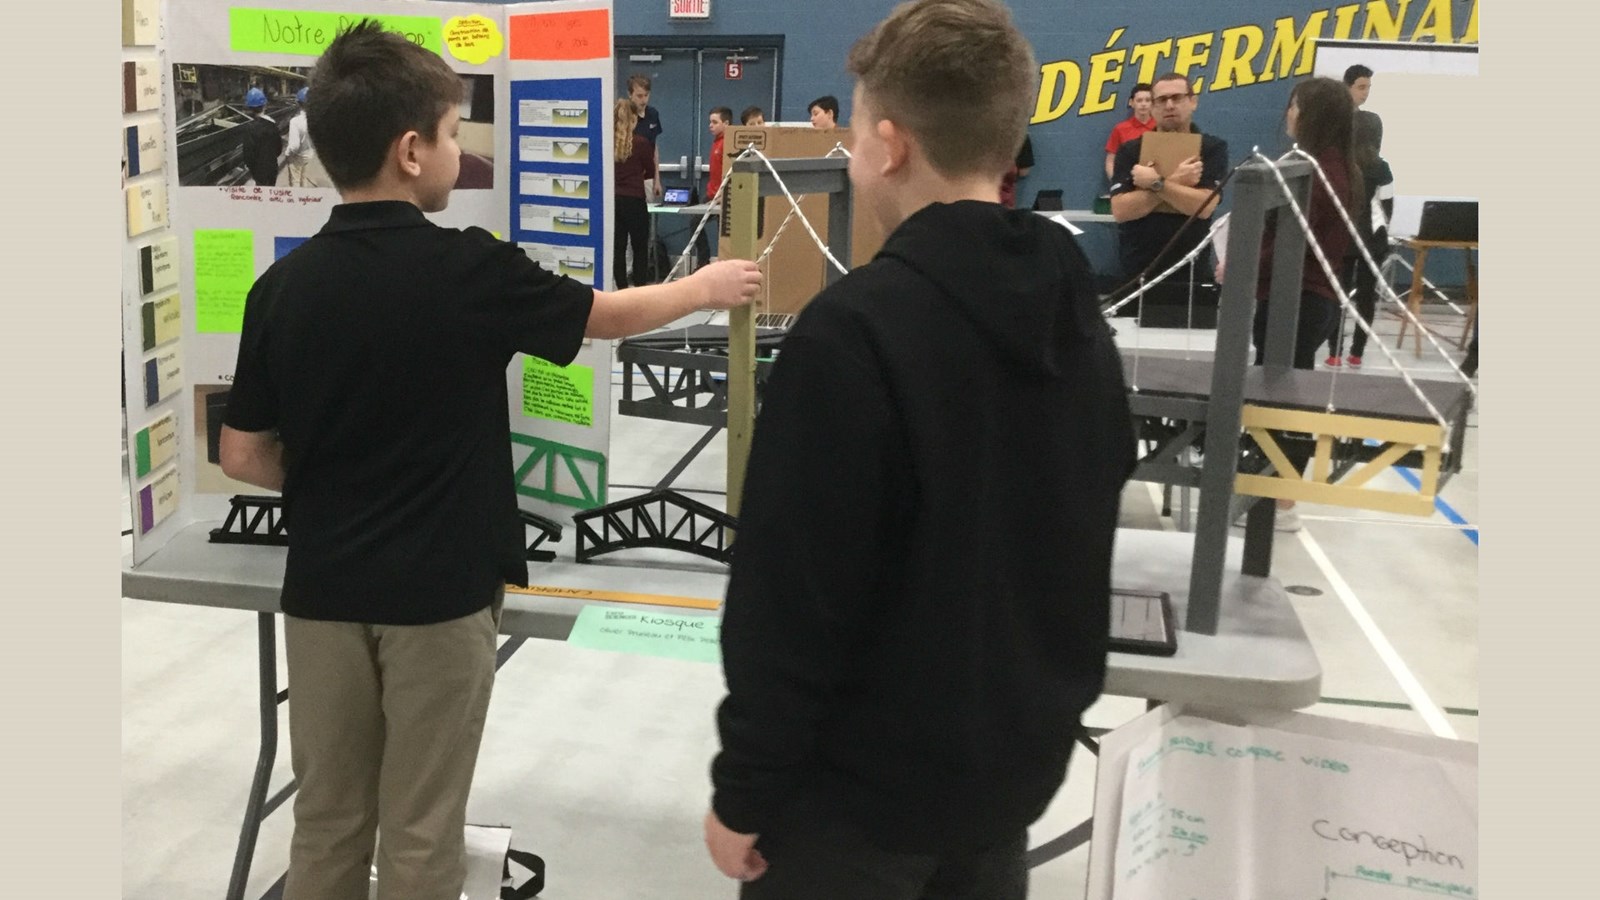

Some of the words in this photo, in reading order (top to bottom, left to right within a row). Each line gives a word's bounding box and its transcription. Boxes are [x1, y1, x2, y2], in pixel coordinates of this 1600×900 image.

[674, 0, 705, 14] SORTIE
[263, 14, 326, 45] Notre
[728, 63, 739, 77] 5
[640, 615, 705, 632] Kiosque
[1312, 819, 1464, 869] Conception
